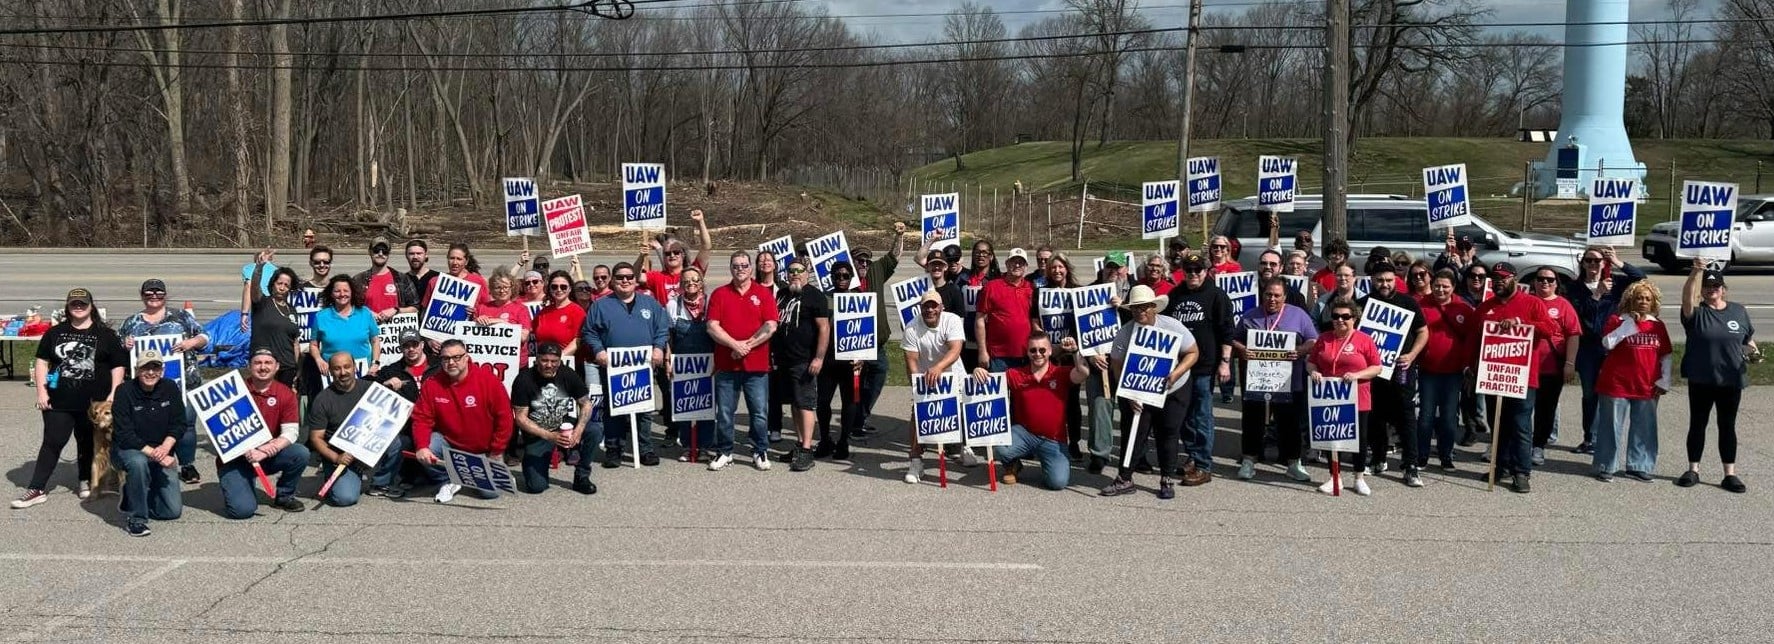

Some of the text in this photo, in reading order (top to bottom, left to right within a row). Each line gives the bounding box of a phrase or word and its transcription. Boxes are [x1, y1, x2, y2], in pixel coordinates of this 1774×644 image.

[626, 166, 661, 183] UAW
[1190, 159, 1216, 174] UAW
[1263, 159, 1293, 173] UAW
[1197, 179, 1209, 191] ON
[1270, 178, 1282, 190] ON
[1427, 167, 1460, 186] UAW
[507, 181, 534, 196] UAW
[635, 189, 650, 204] ON
[1146, 183, 1175, 199] UAW
[1191, 189, 1219, 204] STRIKE
[1261, 189, 1292, 203] STRIKE
[1438, 189, 1452, 204] ON
[1594, 180, 1633, 198] UAW
[1687, 185, 1733, 206] UAW
[516, 201, 526, 214] ON
[544, 197, 578, 211] UAW
[628, 203, 662, 220] STRIKE
[925, 196, 955, 211] UAW
[1153, 203, 1167, 218] ON
[1432, 201, 1465, 220] STRIKE
[1602, 204, 1620, 219] ON
[510, 213, 538, 228] STRIKE
[548, 208, 581, 232] PROTEST
[932, 214, 945, 228] ON
[1146, 214, 1176, 232] STRIKE
[1592, 219, 1632, 236] STRIKE
[1696, 213, 1715, 228] ON
[555, 229, 582, 240] UNFAIR
[558, 237, 583, 247] LABOR
[925, 225, 956, 242] SIKE
[1682, 229, 1729, 246] STRIKE
[555, 242, 589, 255] PRACTICE
[810, 235, 841, 258] UAW
[438, 277, 476, 301] UAW
[896, 277, 929, 302] UAW
[1219, 274, 1254, 294] UAW
[838, 296, 872, 313] UAW
[1042, 292, 1074, 309] UAW
[1076, 287, 1112, 308] UAW
[440, 303, 457, 317] ON
[1367, 303, 1408, 330] UAW
[426, 316, 457, 333] STRIK
[846, 319, 861, 334] ON
[1051, 315, 1064, 329] ON
[1089, 312, 1104, 328] ON
[462, 326, 513, 338] PUBLIC
[1082, 325, 1119, 346] STRIKE
[1134, 327, 1178, 354] UAW
[1255, 332, 1288, 349] UAW
[1371, 331, 1388, 345] ON
[134, 338, 176, 357] UAW
[465, 344, 518, 356] ERVICE
[839, 333, 874, 351] STRIKE
[1484, 341, 1529, 359] PROTEST
[611, 350, 647, 368] UAW
[674, 356, 710, 374] UAW
[1138, 356, 1158, 373] ON
[1487, 364, 1521, 375] UNFAIR
[1487, 373, 1518, 383] LABOR
[621, 373, 637, 388] ON
[684, 380, 699, 395] ON
[964, 376, 1001, 396] UAW
[1124, 373, 1164, 393] STRIKE
[1480, 381, 1524, 394] PRACTICE
[194, 376, 238, 411] UAW
[614, 384, 650, 407] STRIKE
[1312, 381, 1352, 400] UAW
[366, 386, 401, 418] UAW
[676, 393, 712, 412] STRIKE
[927, 401, 944, 417] ON
[976, 402, 992, 418] ON
[219, 406, 239, 427] ON
[1323, 407, 1340, 422] ON
[217, 412, 261, 449] STRIKE
[921, 415, 957, 434] STRIKE
[969, 416, 1006, 437] STRIKE
[1315, 423, 1355, 440] STRIKE
[340, 425, 386, 453] STKE
[453, 453, 477, 487] STRIKE
[471, 465, 487, 480] ON
[489, 461, 515, 494] UAW
